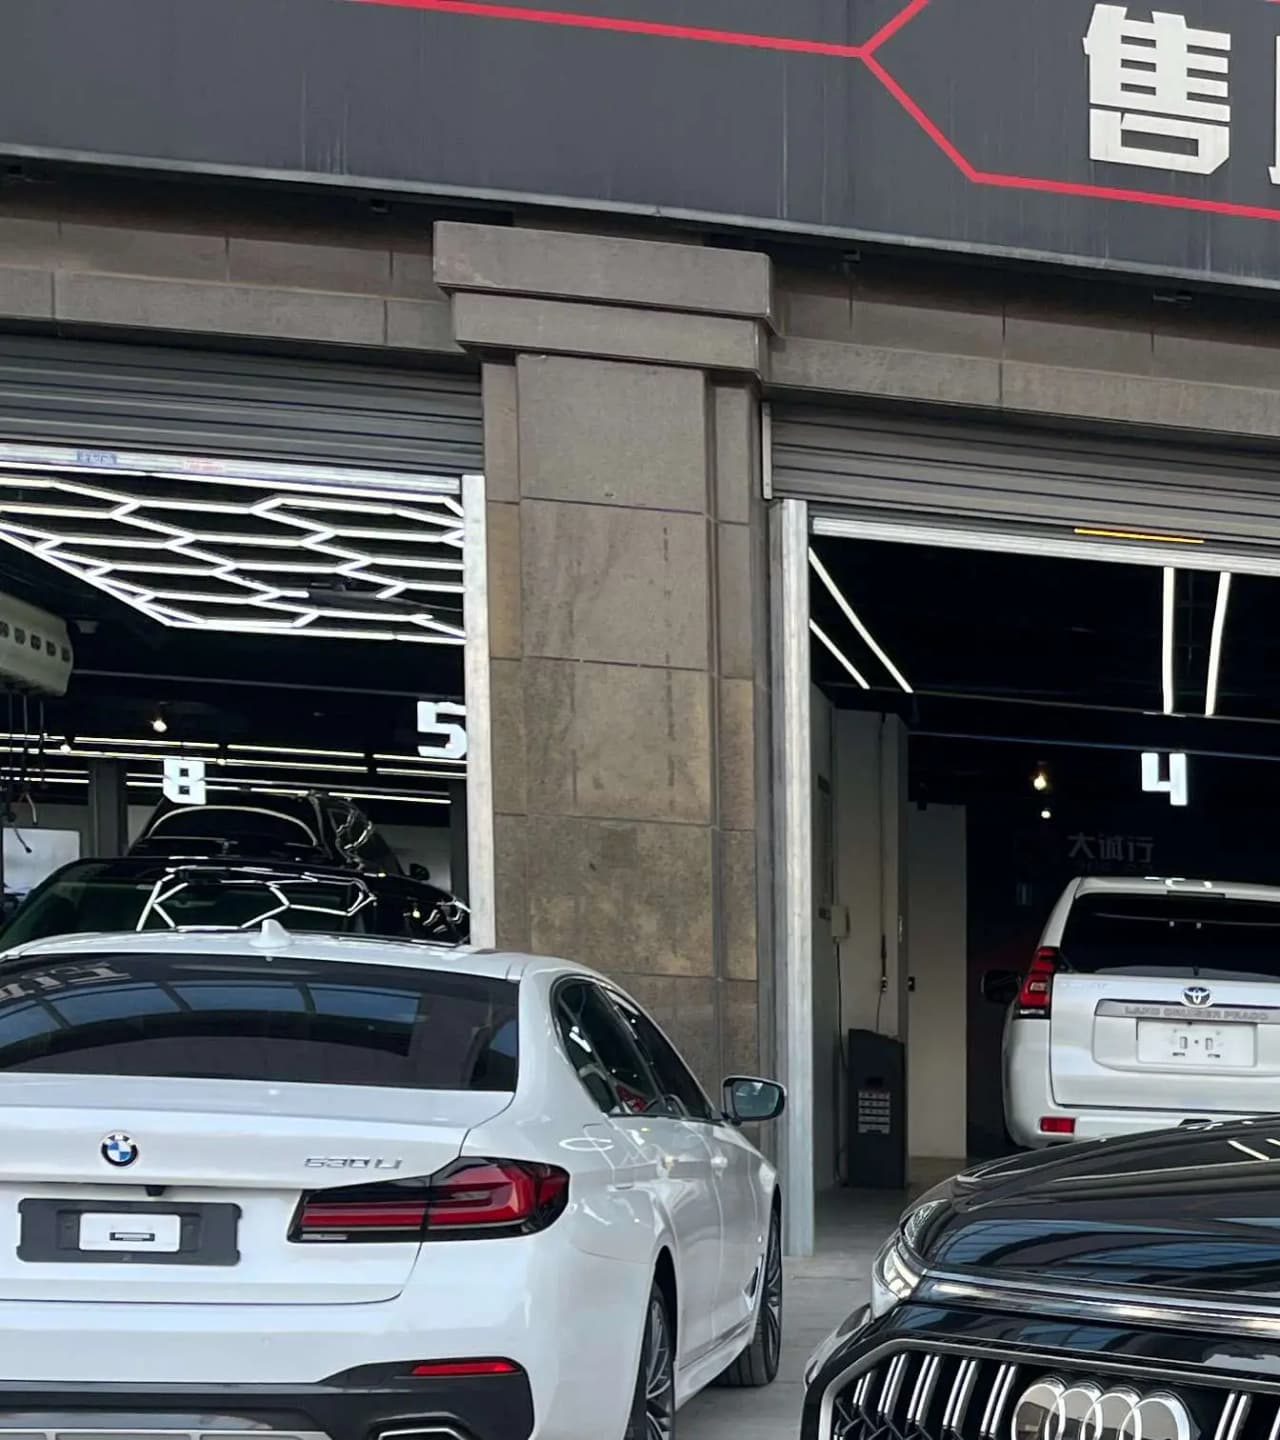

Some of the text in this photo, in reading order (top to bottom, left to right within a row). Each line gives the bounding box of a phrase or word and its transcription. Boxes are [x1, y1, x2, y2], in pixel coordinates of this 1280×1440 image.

[416, 701, 467, 758] 5
[162, 758, 206, 805] 8
[1141, 752, 1188, 806] 4
